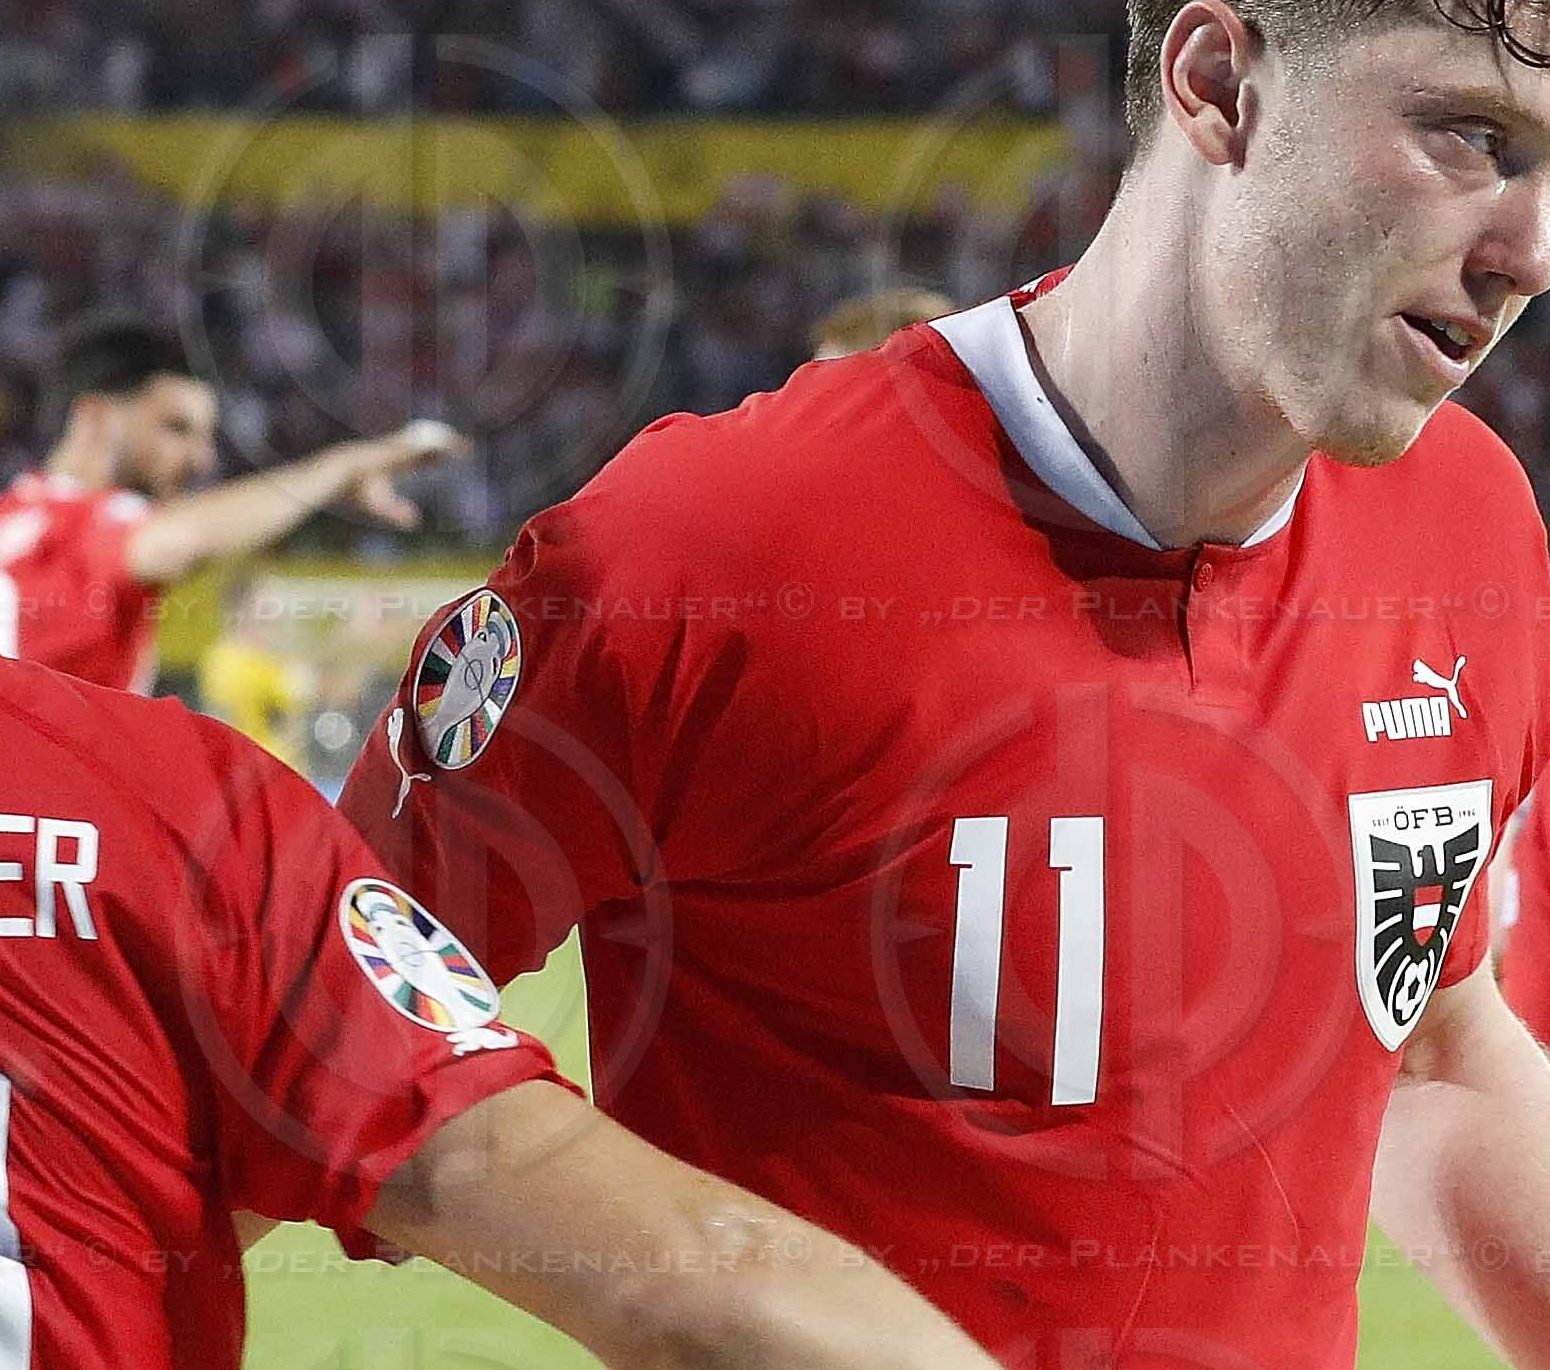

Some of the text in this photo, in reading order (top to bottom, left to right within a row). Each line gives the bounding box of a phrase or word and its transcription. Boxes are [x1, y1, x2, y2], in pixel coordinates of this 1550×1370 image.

[1362, 696, 1452, 743] PUMA
[1394, 805, 1454, 831] ÖFB
[948, 815, 1106, 1106] 11
